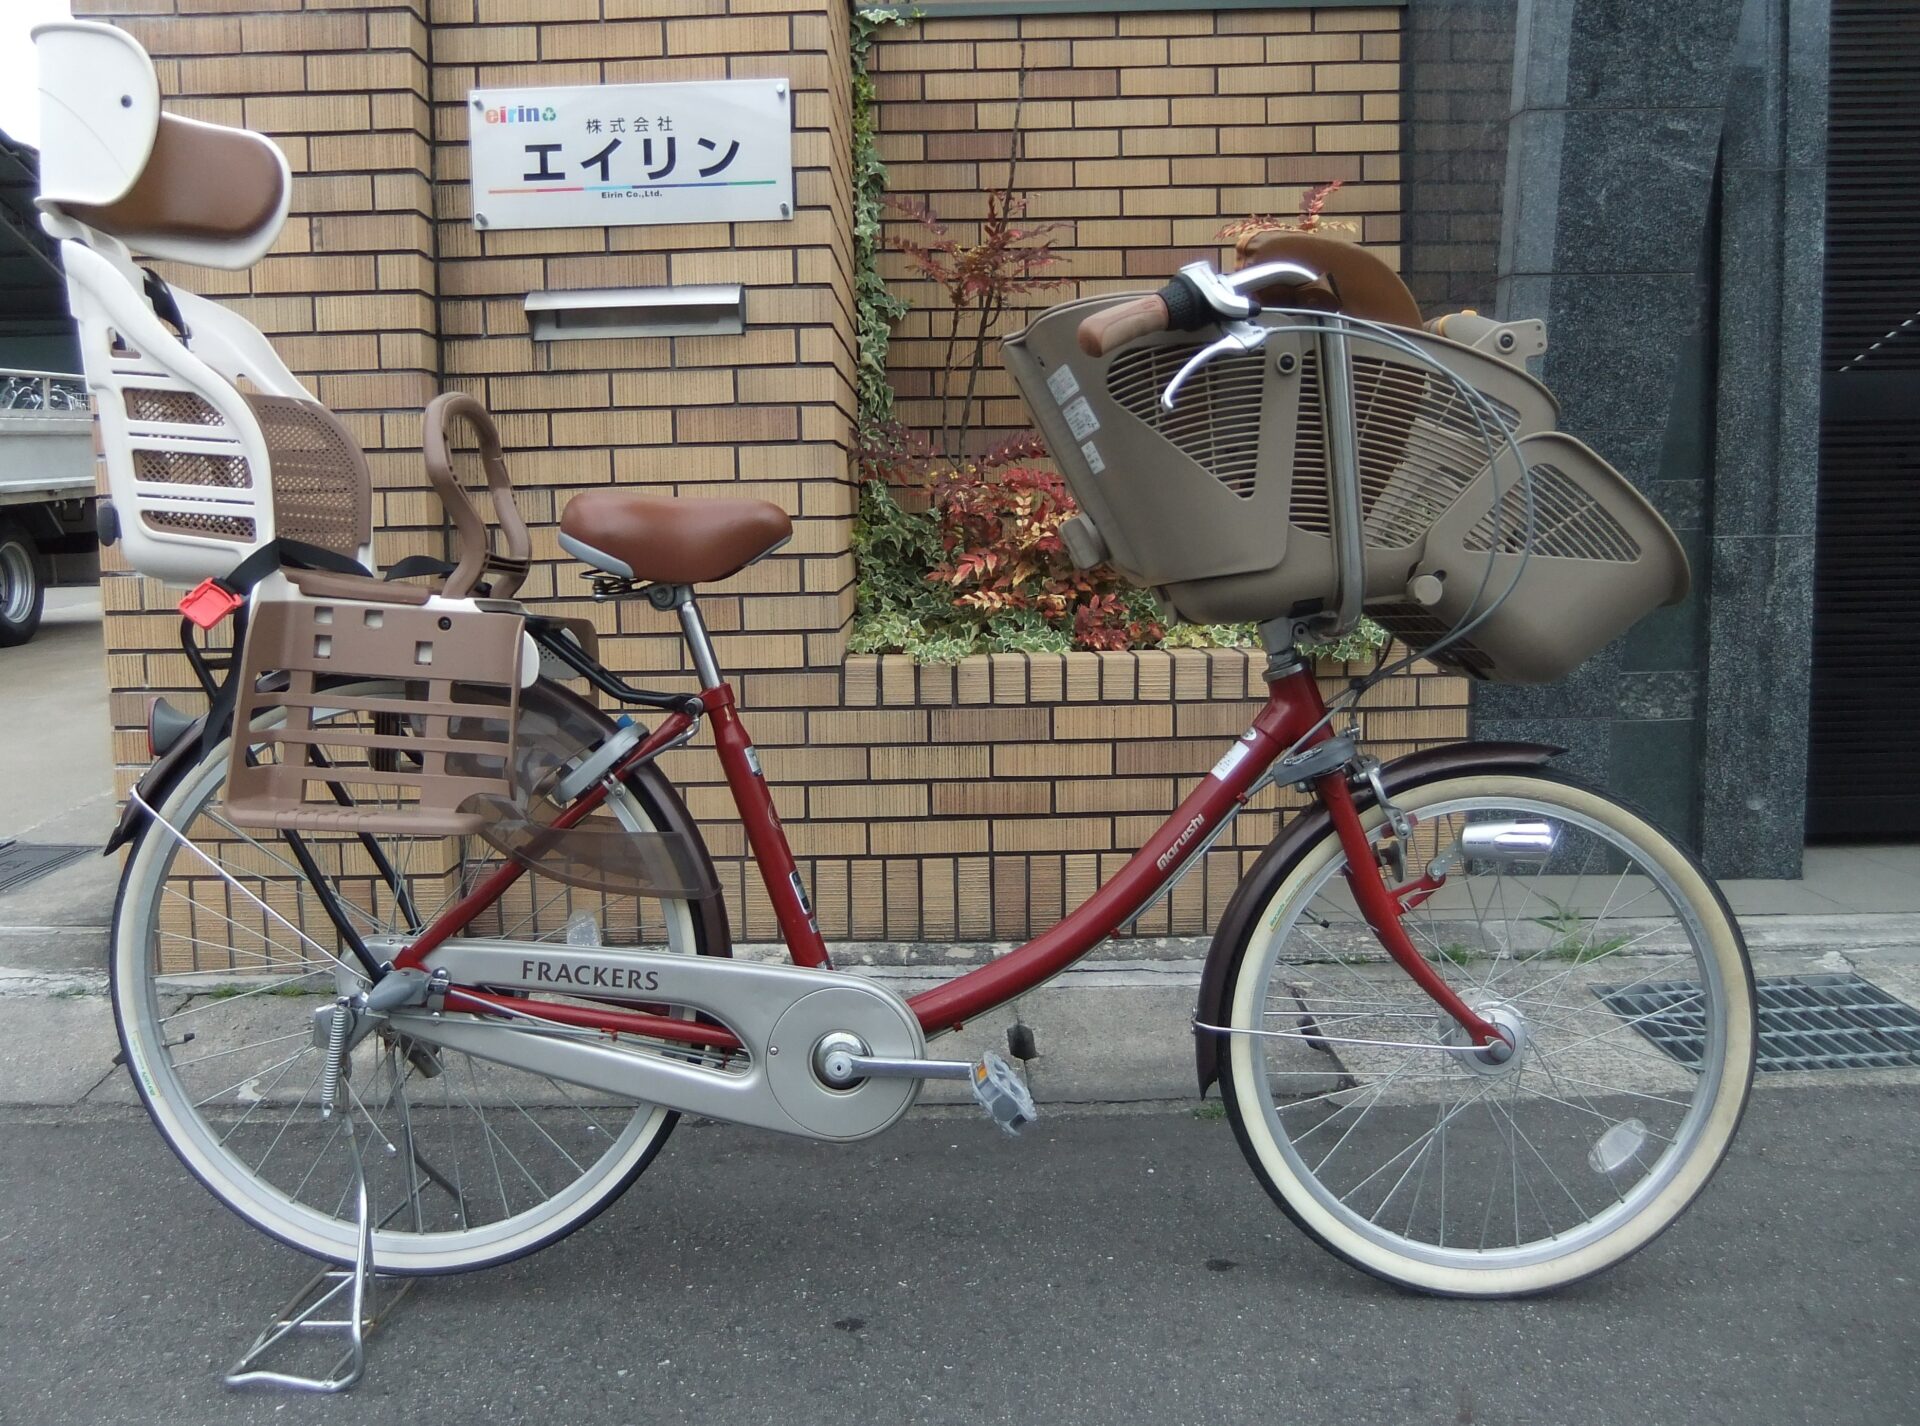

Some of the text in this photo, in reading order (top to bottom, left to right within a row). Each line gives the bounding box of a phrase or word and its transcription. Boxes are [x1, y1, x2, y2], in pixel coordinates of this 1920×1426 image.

[485, 105, 540, 124] eirin
[585, 116, 674, 134] 株式会社
[523, 136, 741, 182] エイリン
[601, 191, 623, 199] Eirin
[522, 960, 659, 991] FRACKERS
